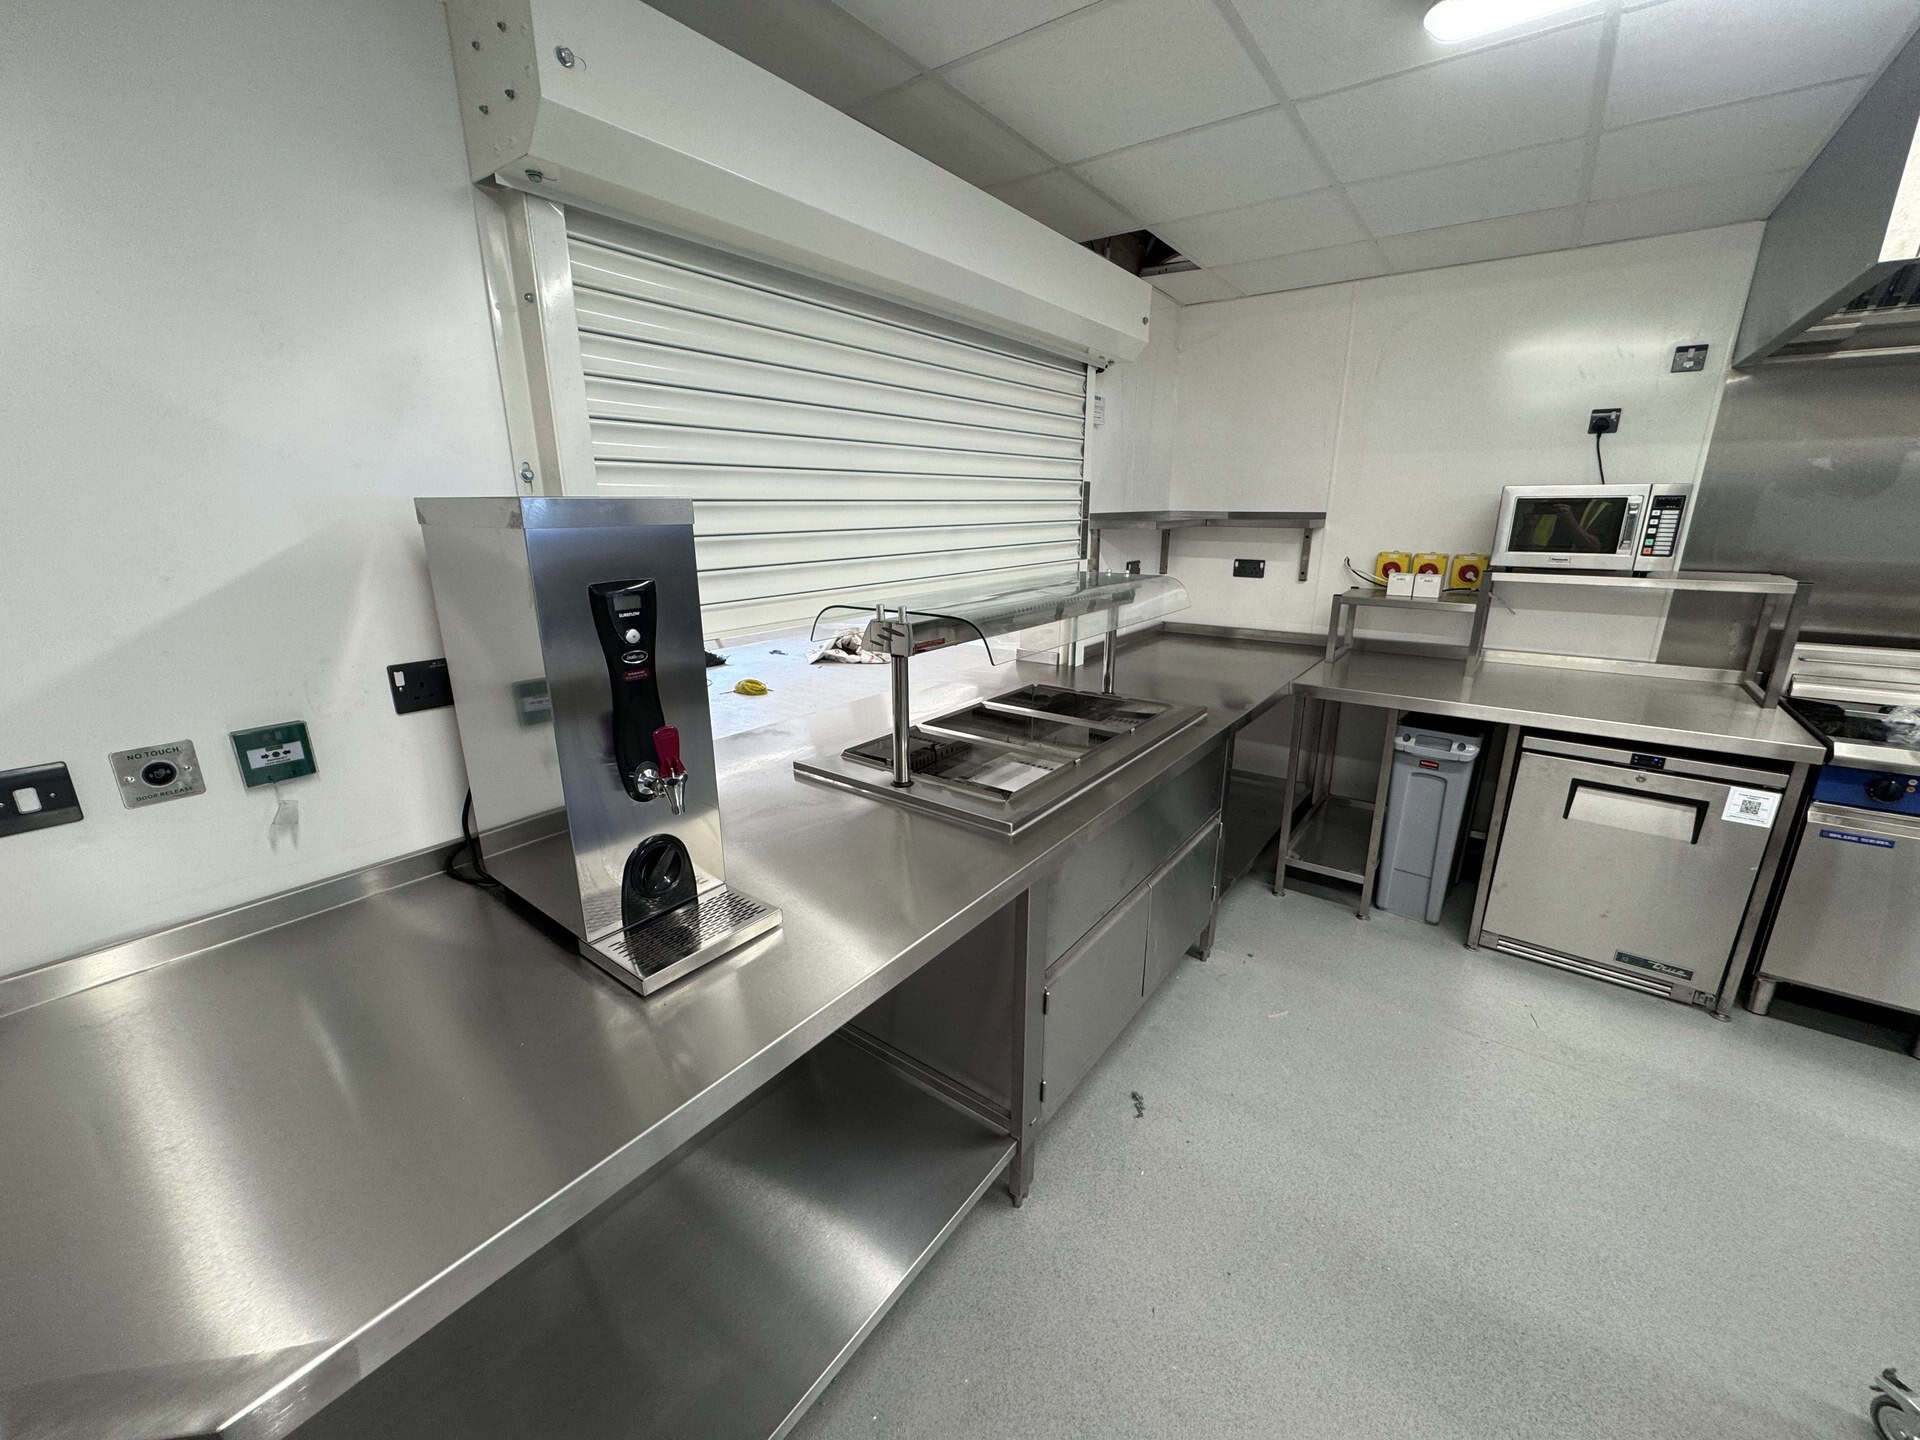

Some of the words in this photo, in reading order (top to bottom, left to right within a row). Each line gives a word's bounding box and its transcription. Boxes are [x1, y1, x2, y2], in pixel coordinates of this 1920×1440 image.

[127, 753, 142, 761] NO
[144, 746, 180, 758] TOUCH
[136, 793, 158, 802] DOOR
[159, 786, 193, 797] RELEASE
